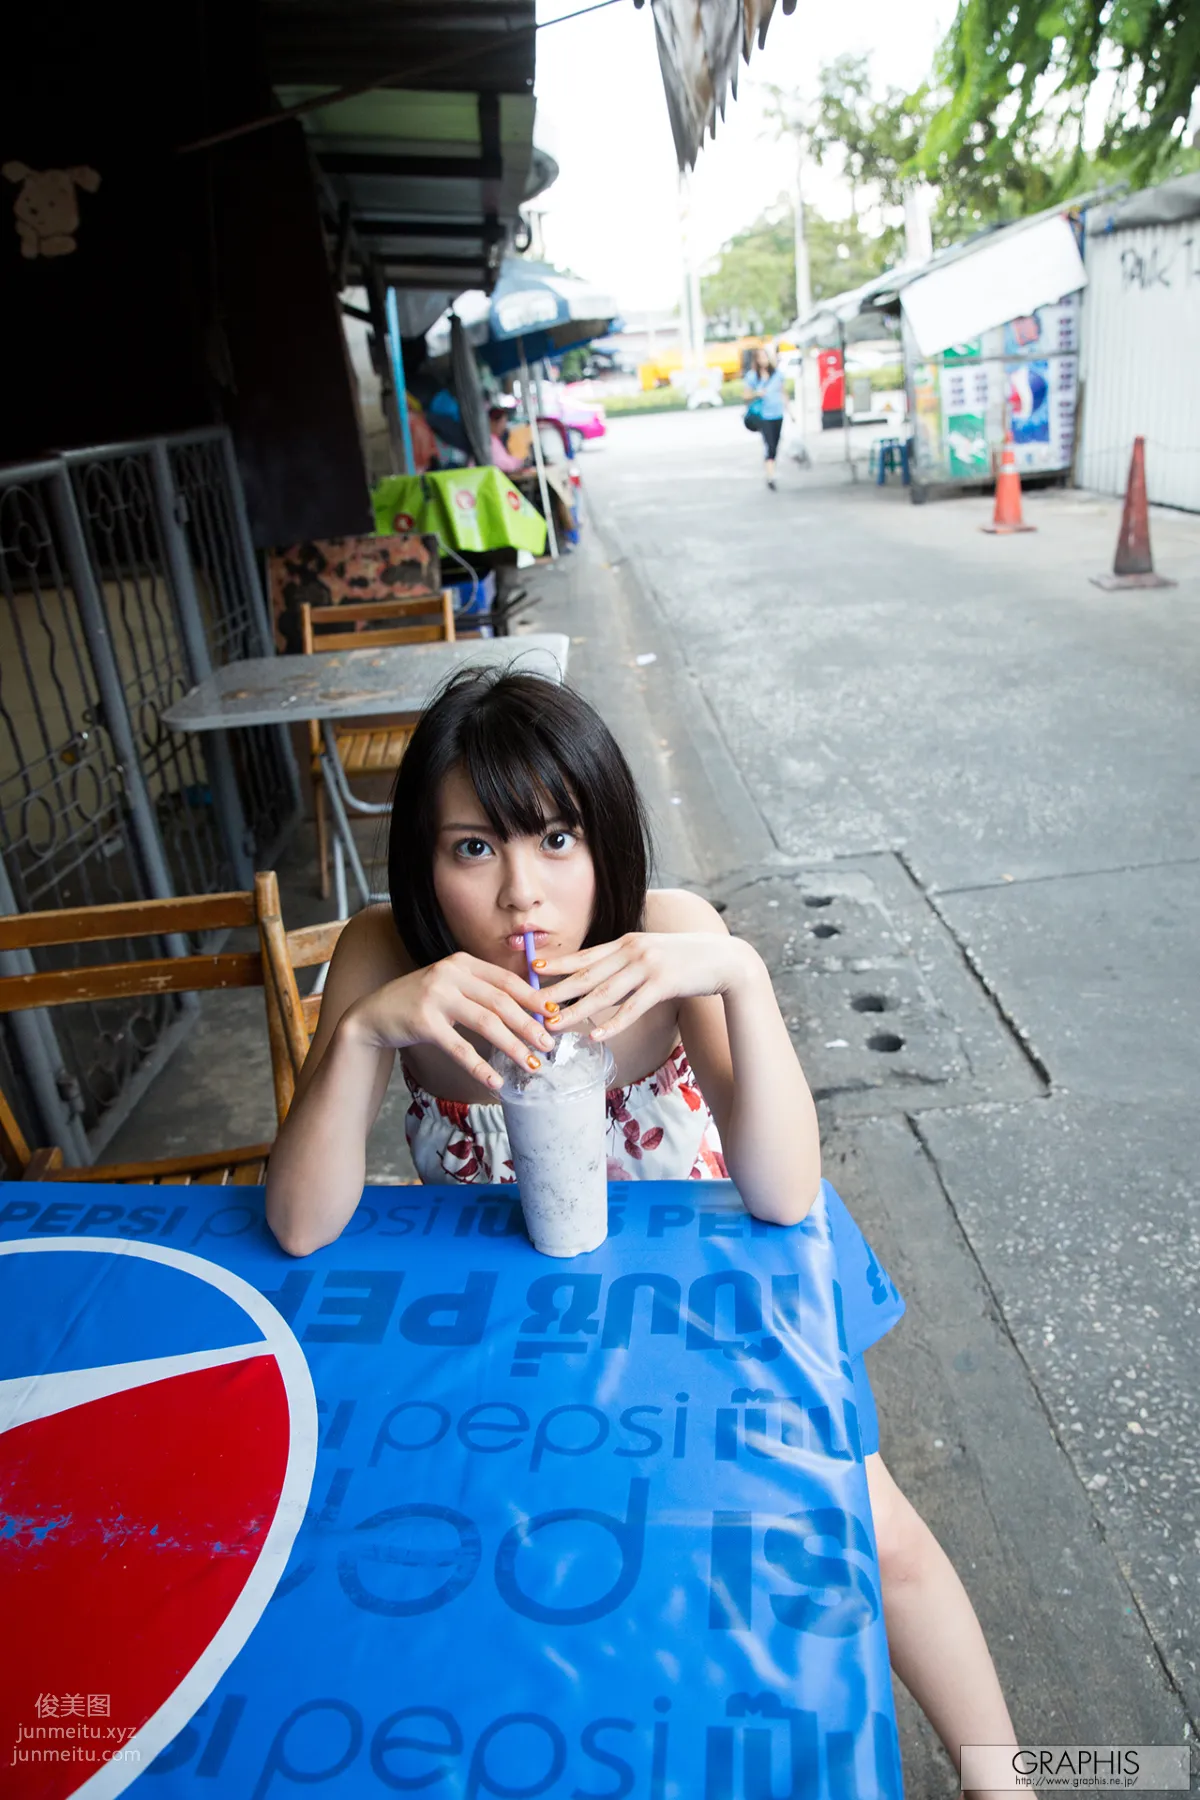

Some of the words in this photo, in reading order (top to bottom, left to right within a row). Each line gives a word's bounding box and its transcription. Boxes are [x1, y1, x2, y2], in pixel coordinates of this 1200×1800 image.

[0, 1201, 189, 1237] PEPSI
[367, 1391, 690, 1472] pepsi
[252, 1695, 672, 1800] pepsi
